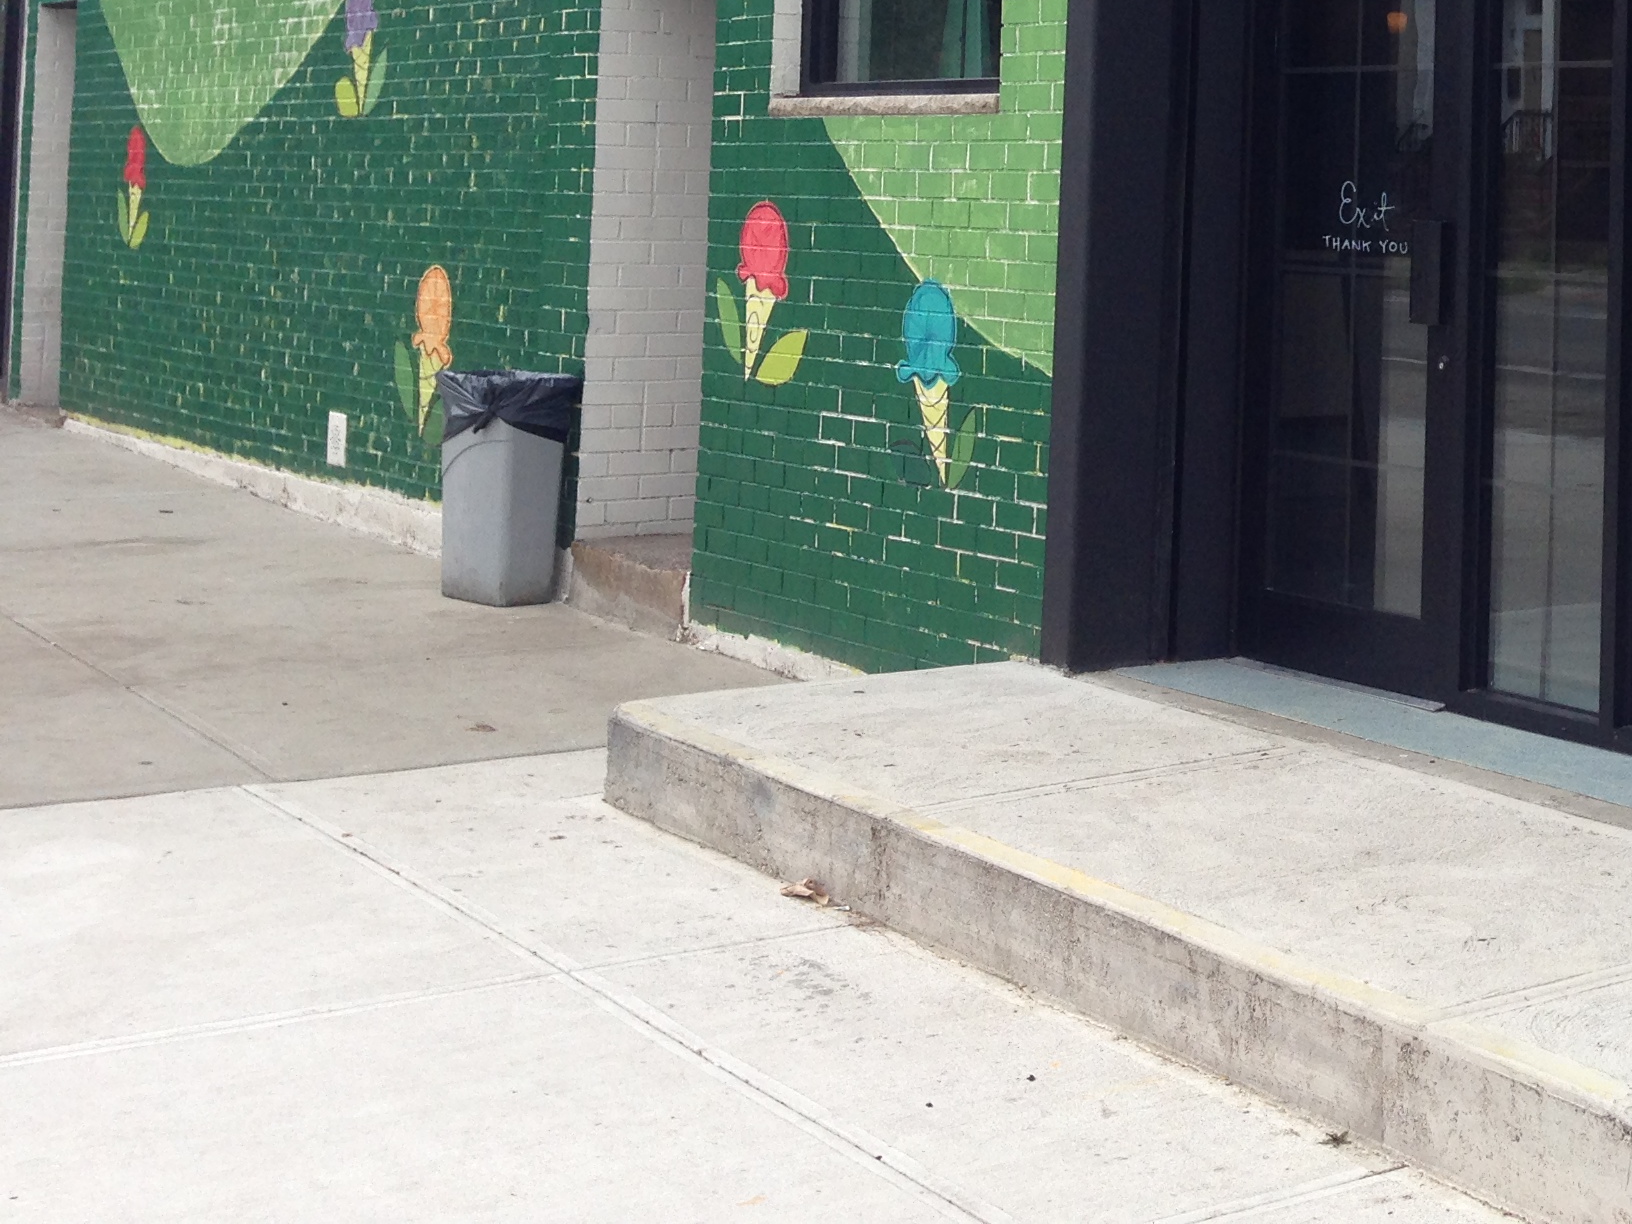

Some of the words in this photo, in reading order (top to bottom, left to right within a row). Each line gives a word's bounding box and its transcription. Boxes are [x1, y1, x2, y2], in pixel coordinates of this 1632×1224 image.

[1339, 180, 1396, 232] Exit
[1322, 235, 1372, 253] THANK
[1379, 239, 1408, 254] YOU
